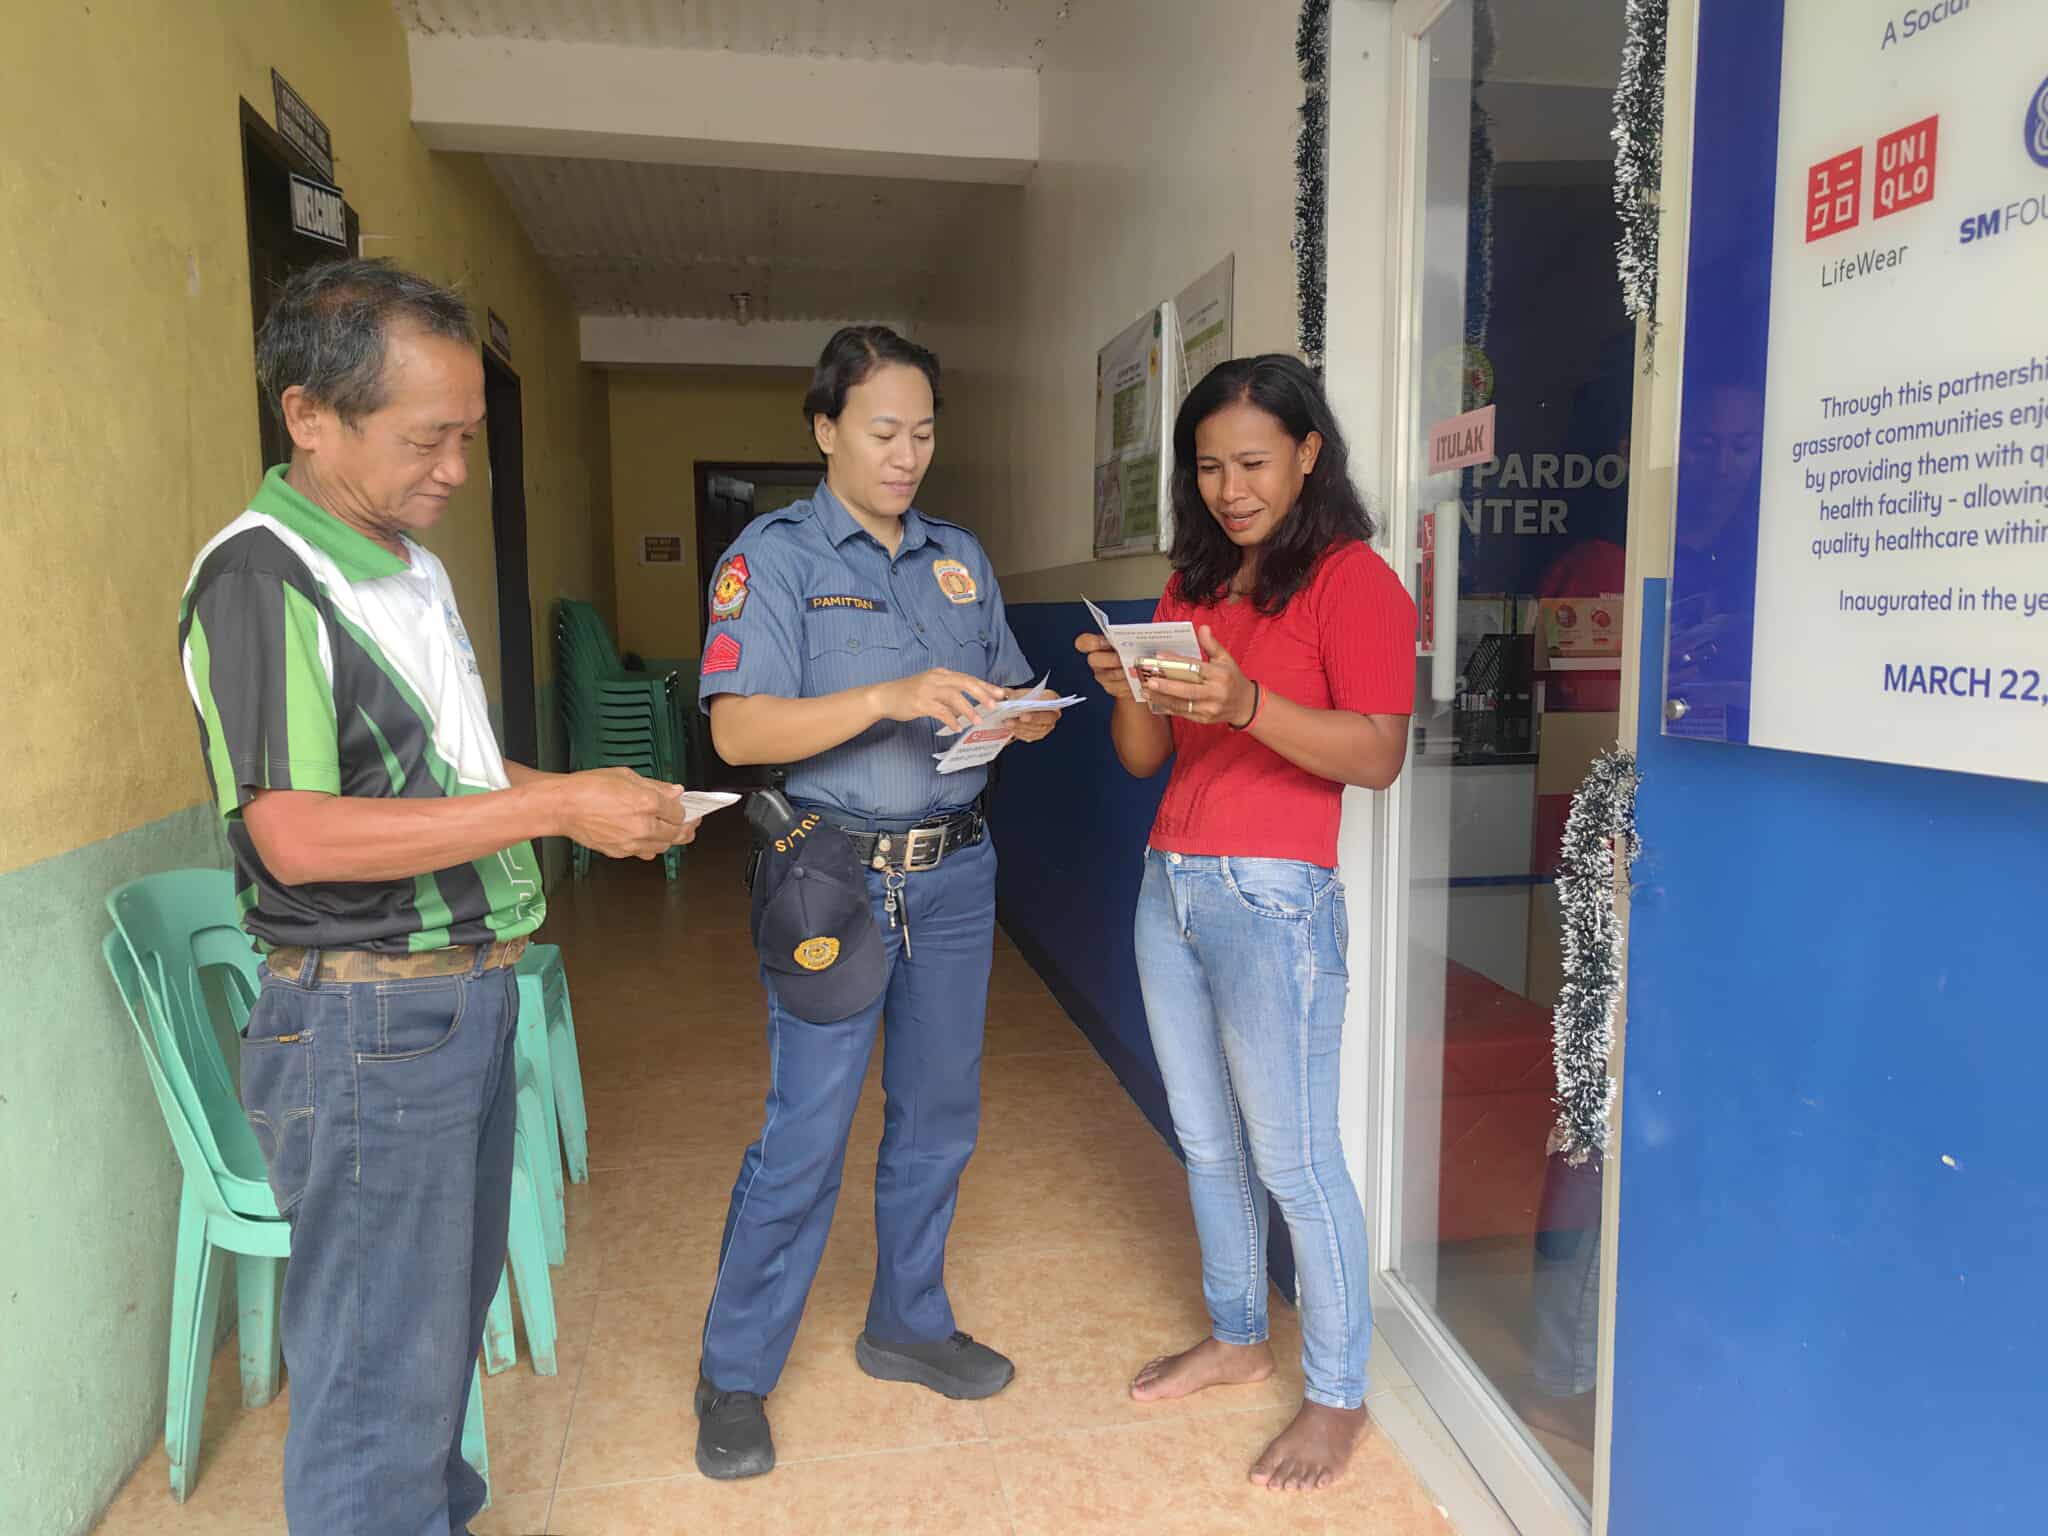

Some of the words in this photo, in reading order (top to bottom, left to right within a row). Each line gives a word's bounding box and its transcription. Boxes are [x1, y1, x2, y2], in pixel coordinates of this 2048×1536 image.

[1881, 21, 1897, 50] A
[1903, 0, 1970, 38] Socia
[1882, 130, 1926, 173] UNI
[1880, 165, 1929, 208] QLO
[1821, 246, 1908, 287] LifeWear
[1821, 387, 1892, 420] Through
[1897, 380, 1932, 405] this
[1436, 425, 1485, 463] ITULAK
[1792, 427, 1871, 462] grassroot
[1875, 407, 2004, 446] communities
[1473, 453, 1627, 489] PARDO
[1805, 465, 1825, 492] by
[1830, 457, 1912, 491] providing
[1917, 450, 1969, 476] them
[1975, 439, 2023, 469] with
[1820, 497, 1872, 521] health
[1878, 491, 1942, 516] facility
[1811, 532, 1870, 560] quality
[1875, 524, 1979, 553] healthcare
[812, 596, 873, 610] PAMITTAN
[1839, 587, 1952, 616] Inaugurated
[1958, 587, 1976, 611] in
[1981, 585, 2018, 611] the
[1884, 663, 1991, 699] MARCH
